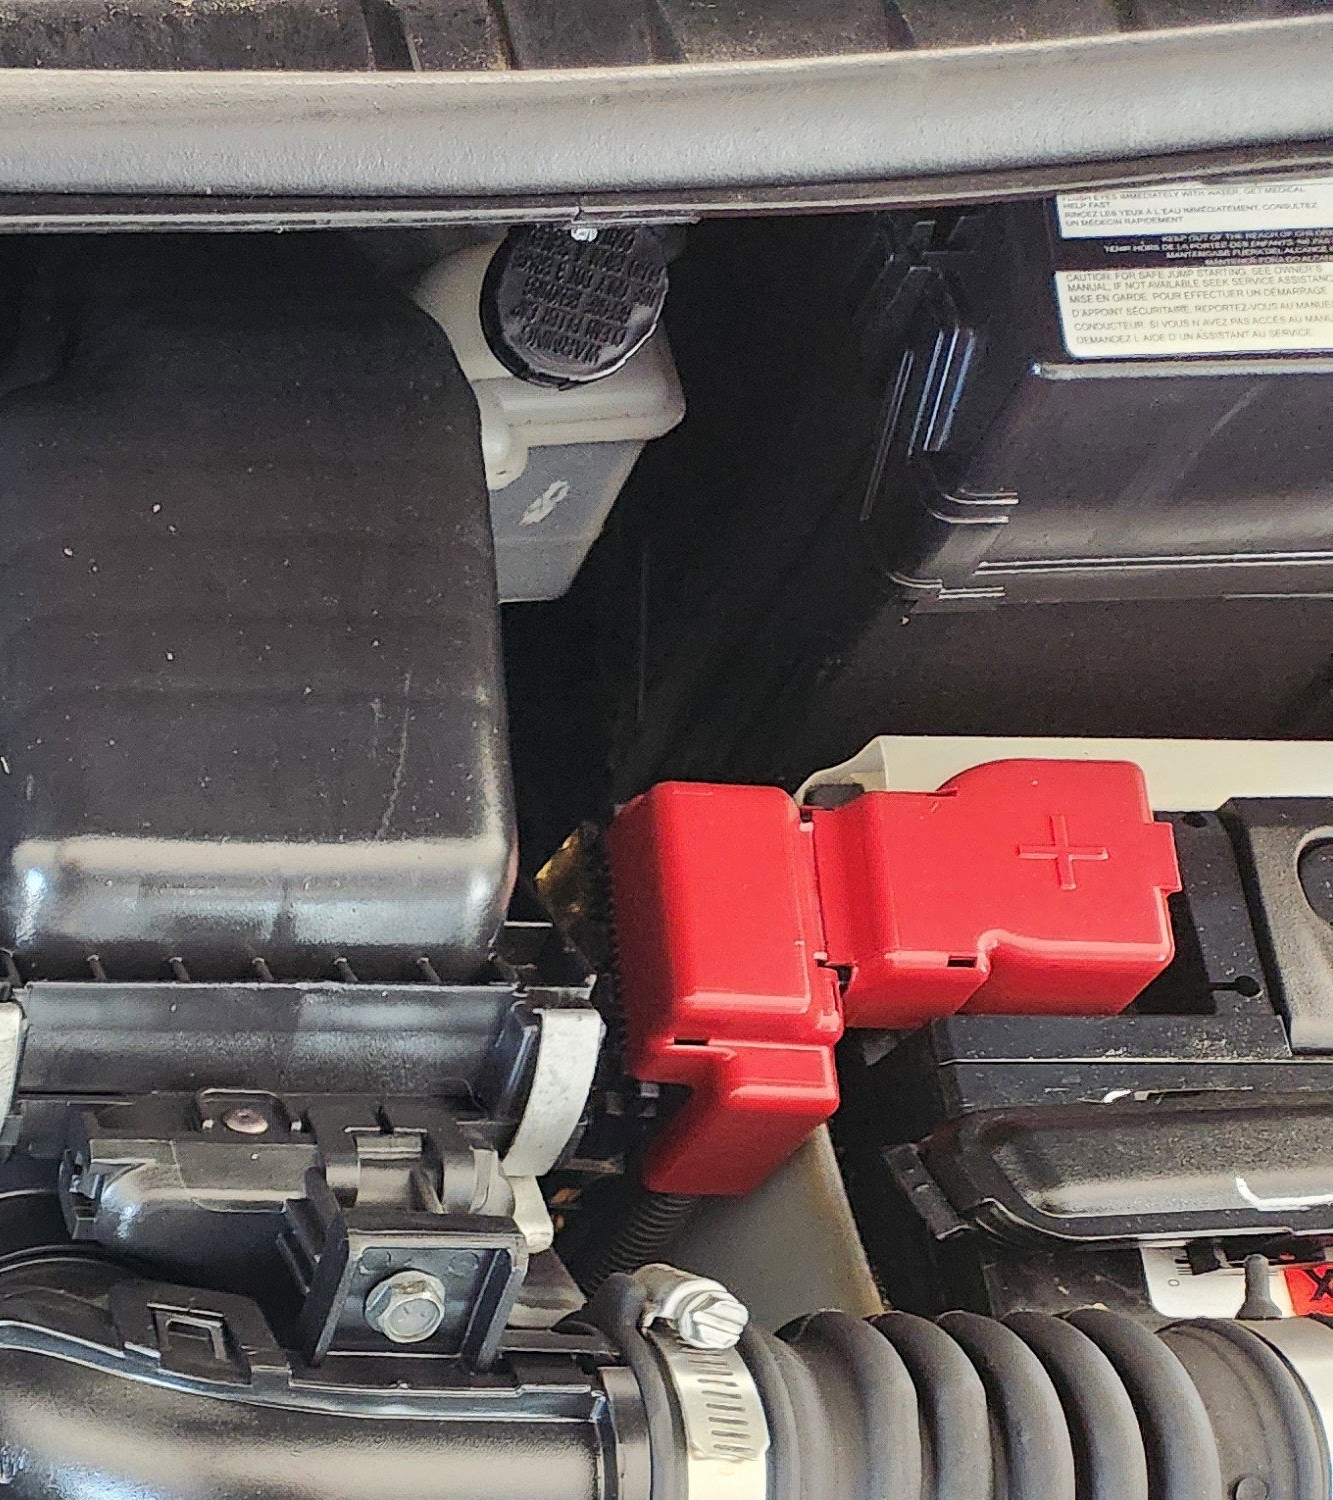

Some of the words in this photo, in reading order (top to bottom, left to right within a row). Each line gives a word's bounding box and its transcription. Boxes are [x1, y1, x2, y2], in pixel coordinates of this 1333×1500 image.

[1115, 271, 1135, 280] FOR
[1139, 271, 1165, 279] SAFE
[1168, 270, 1193, 279] JUMP
[1251, 267, 1271, 275] SEE
[1124, 281, 1146, 289] NOT
[1148, 279, 1200, 288] AVAILABLE
[1202, 279, 1231, 287] SEEK
[1232, 277, 1274, 286] SERVICE
[1069, 295, 1092, 303] MISE
[1096, 294, 1110, 302] EN
[1153, 292, 1181, 300] POUR
[1184, 290, 1244, 299] EFFECTUER
[1246, 289, 1261, 297] UN
[1162, 319, 1190, 327] VOUS
